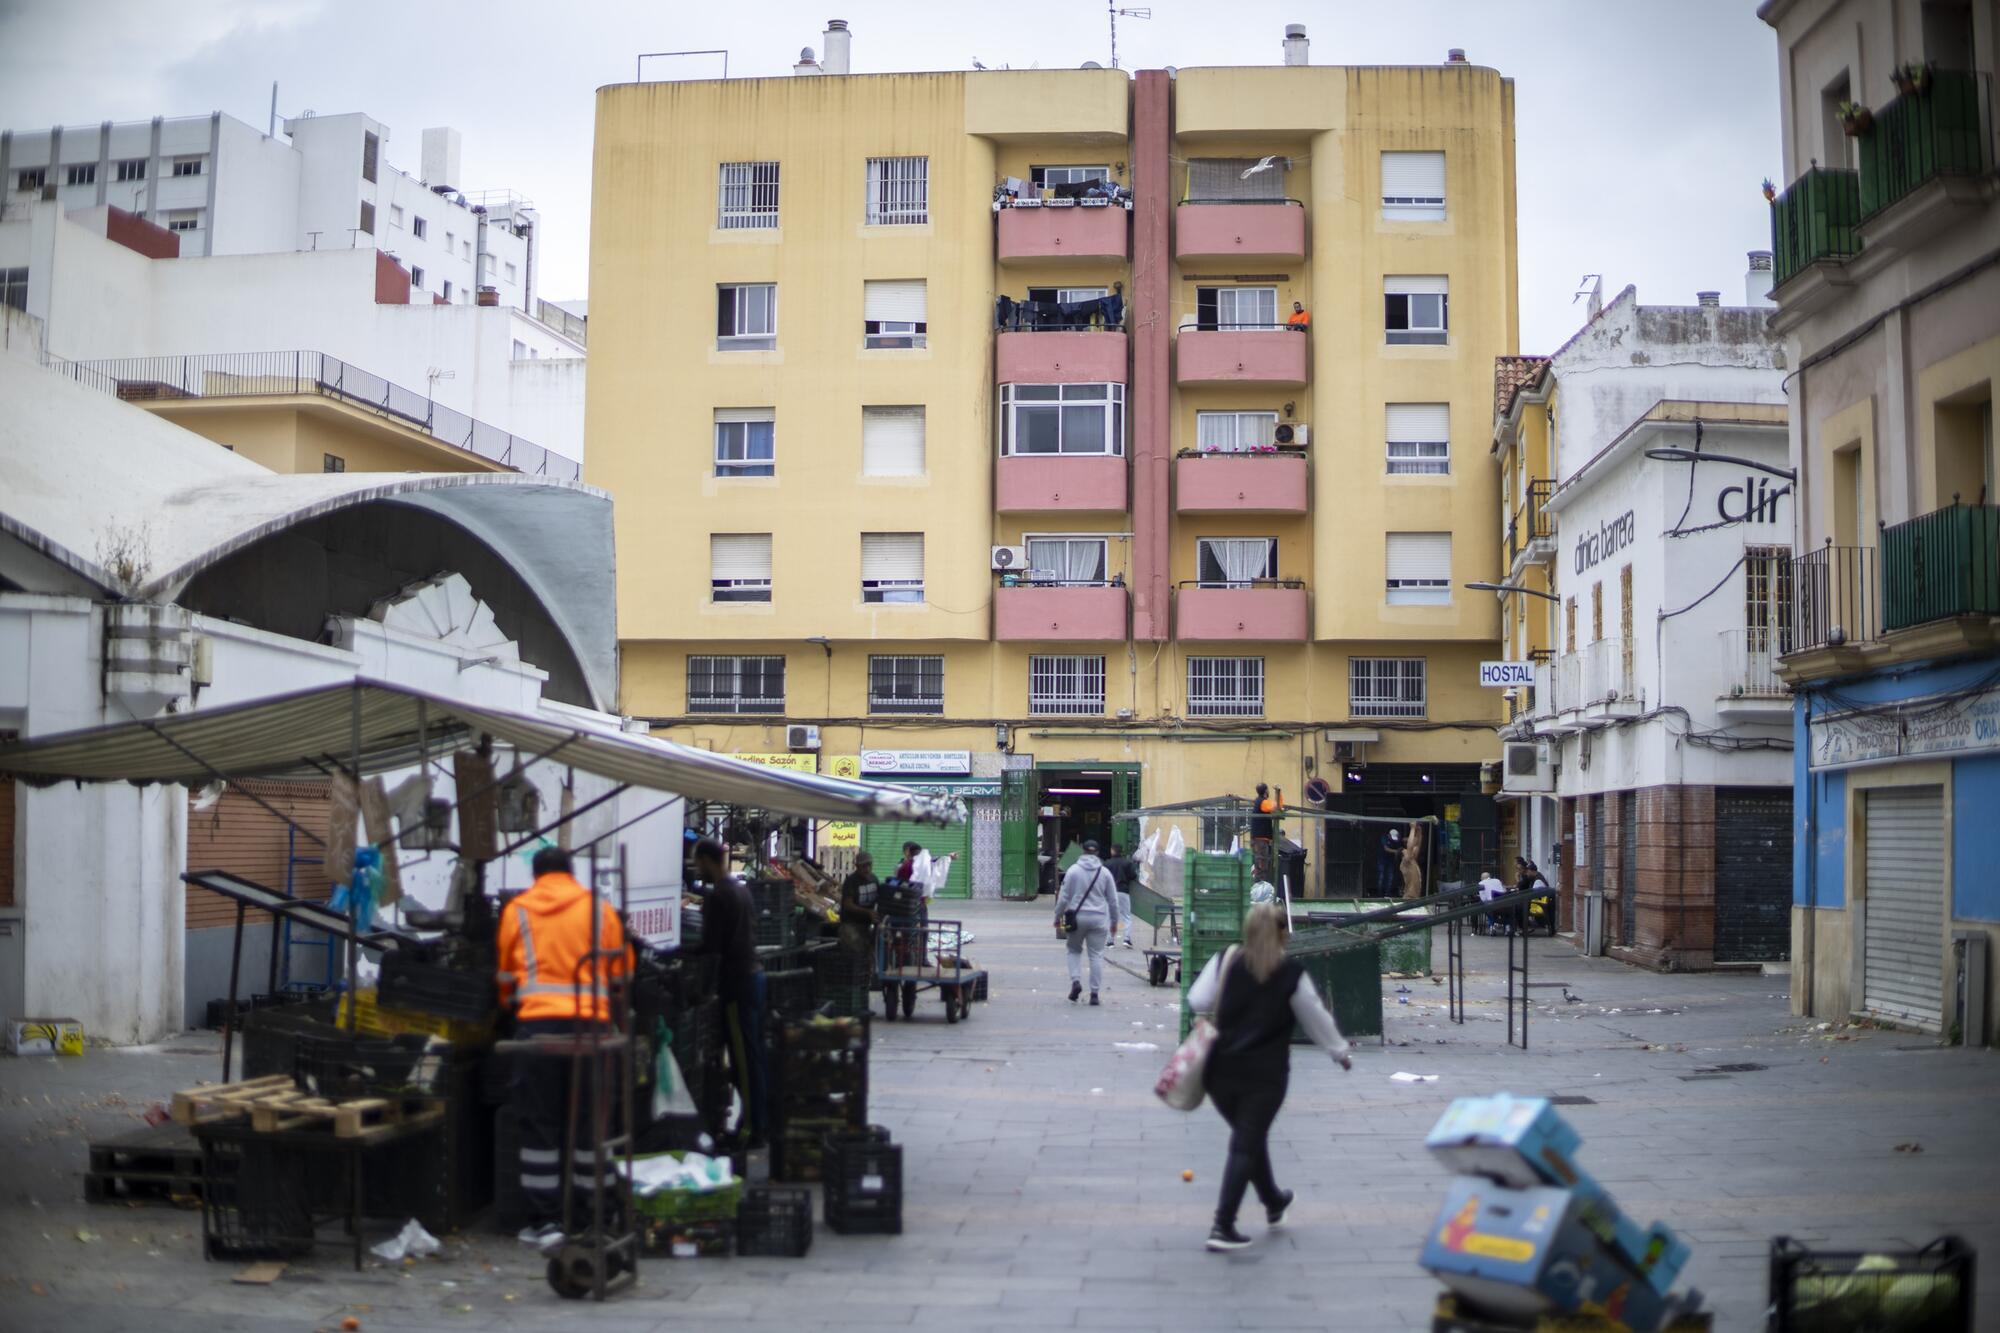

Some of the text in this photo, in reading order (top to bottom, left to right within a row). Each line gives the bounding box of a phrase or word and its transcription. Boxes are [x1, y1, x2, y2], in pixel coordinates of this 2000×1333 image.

[1600, 508, 1634, 560] barrera
[1482, 665, 1533, 682] HOSTAL
[769, 754, 797, 765] Sazón
